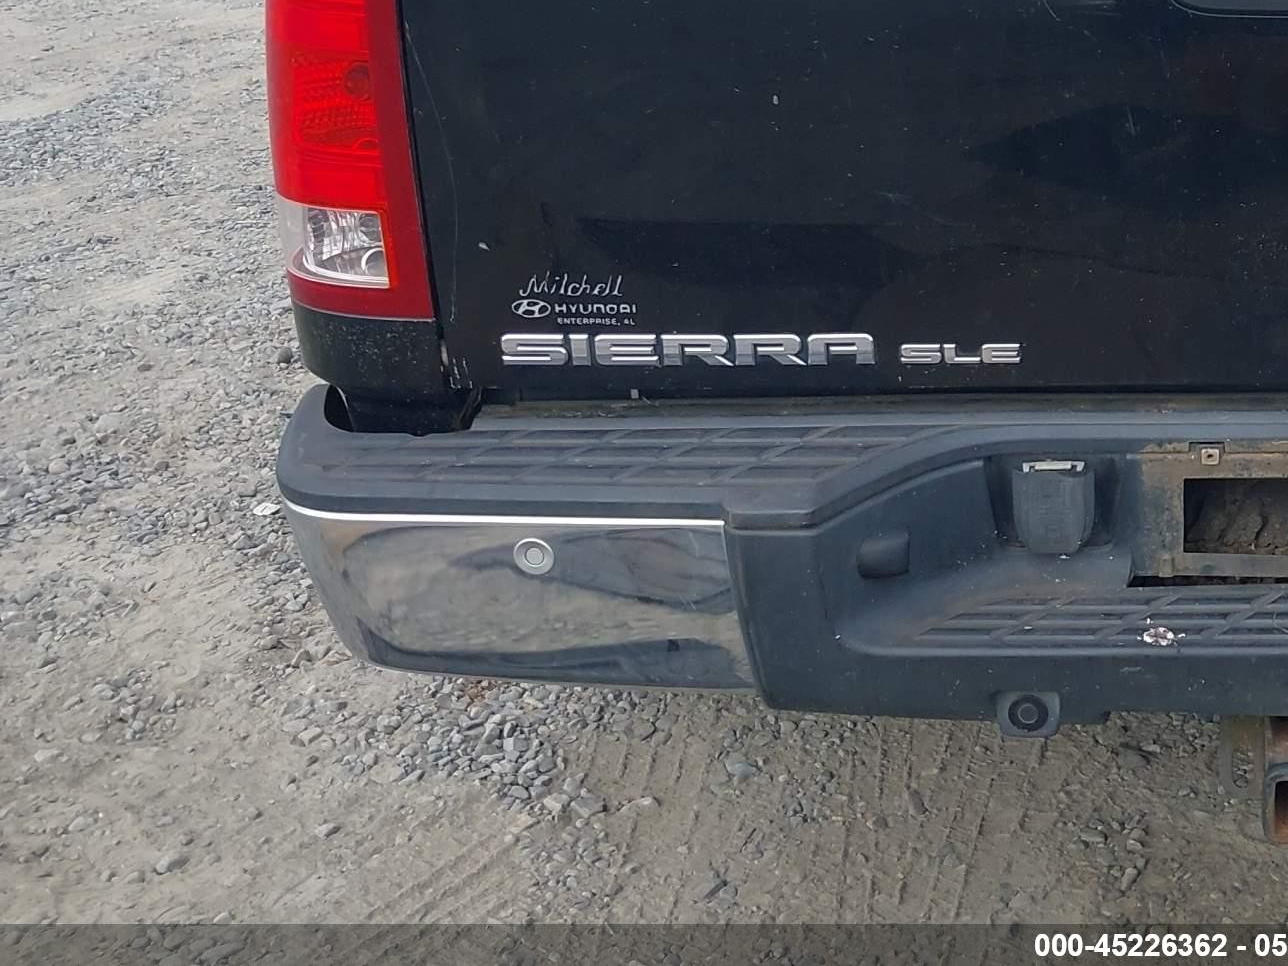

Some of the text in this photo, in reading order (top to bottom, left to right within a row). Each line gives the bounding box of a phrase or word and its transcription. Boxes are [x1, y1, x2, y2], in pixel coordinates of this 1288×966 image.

[554, 303, 636, 315] HYUNDAI
[501, 333, 1022, 366] SIERRA SLE
